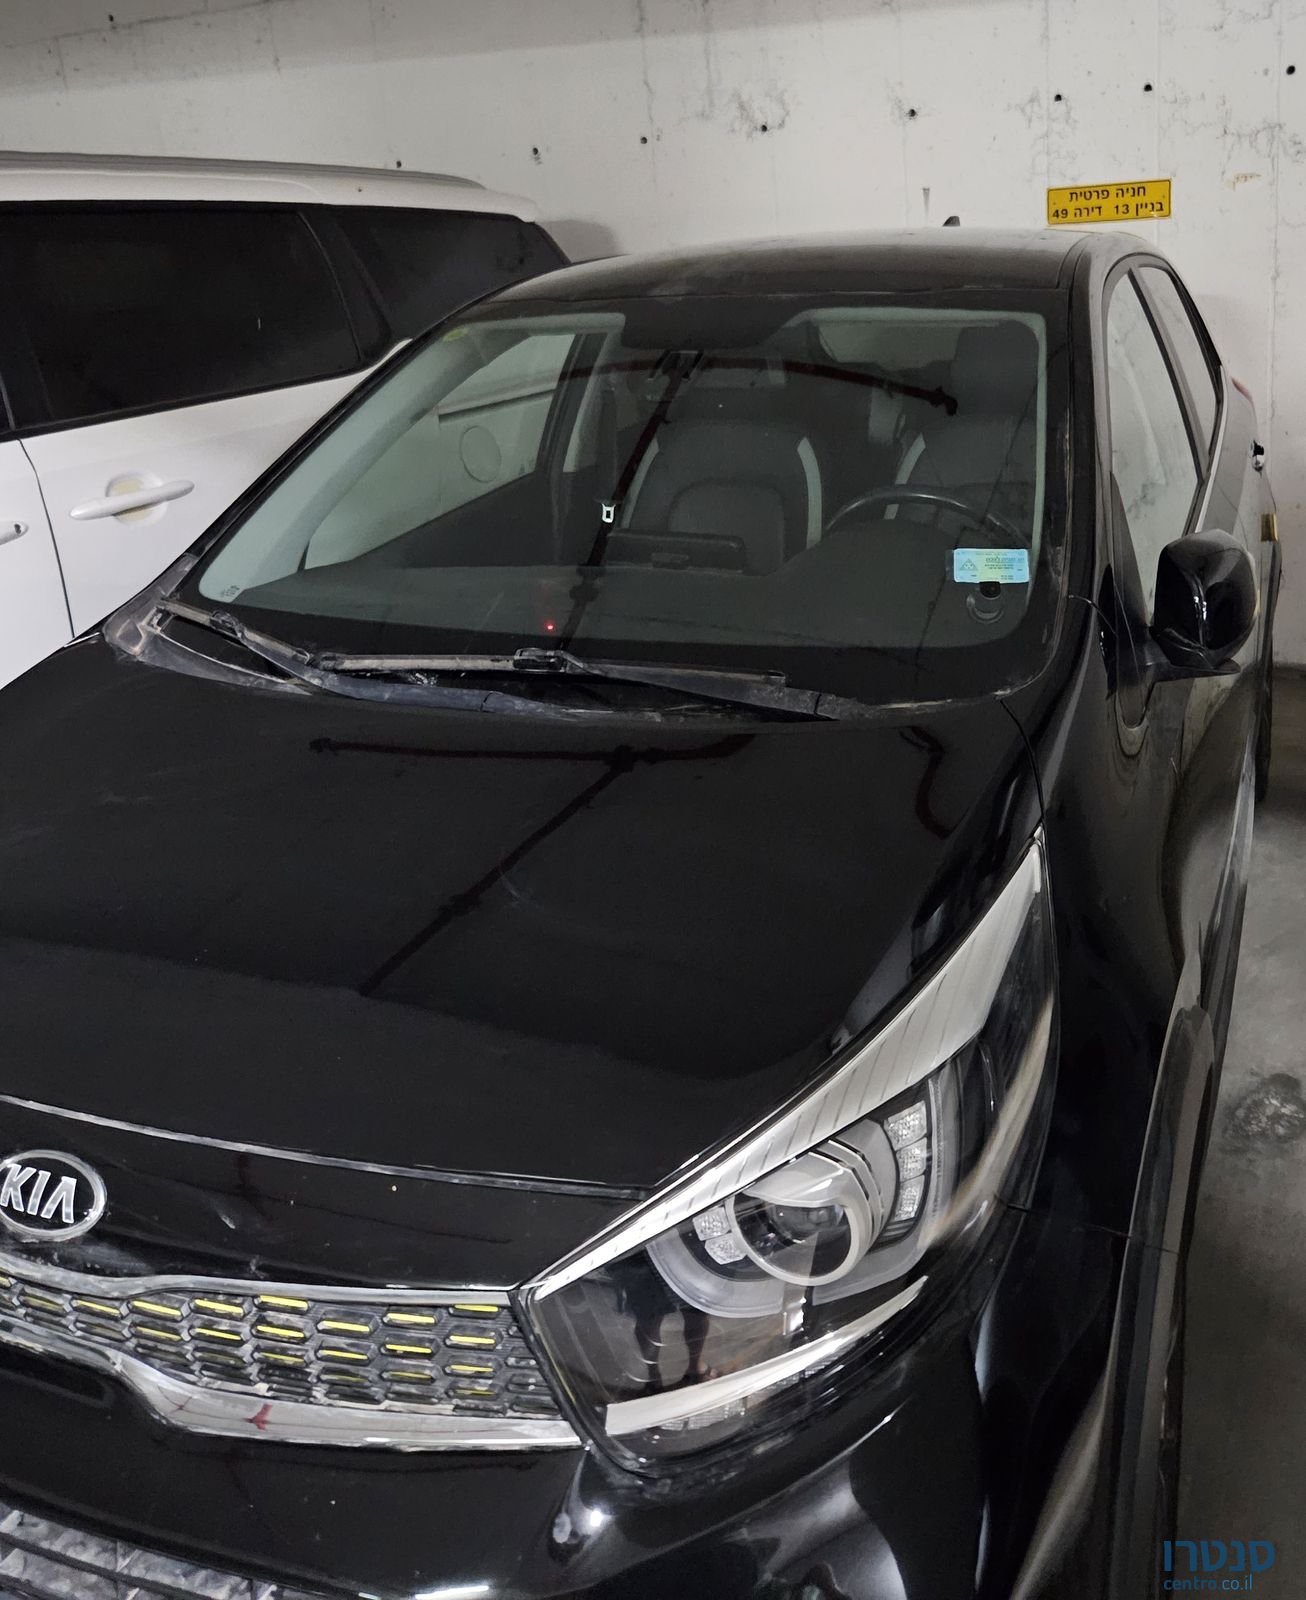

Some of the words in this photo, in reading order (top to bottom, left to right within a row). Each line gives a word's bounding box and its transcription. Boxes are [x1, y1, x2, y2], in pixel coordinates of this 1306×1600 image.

[1069, 189, 1110, 203] פרטית
[1116, 186, 1146, 199] חניה
[1052, 208, 1068, 219] 49
[1074, 206, 1102, 218] דירה
[1114, 203, 1129, 215] 13
[1135, 201, 1164, 216] בניין
[0, 1163, 77, 1223] KIA
